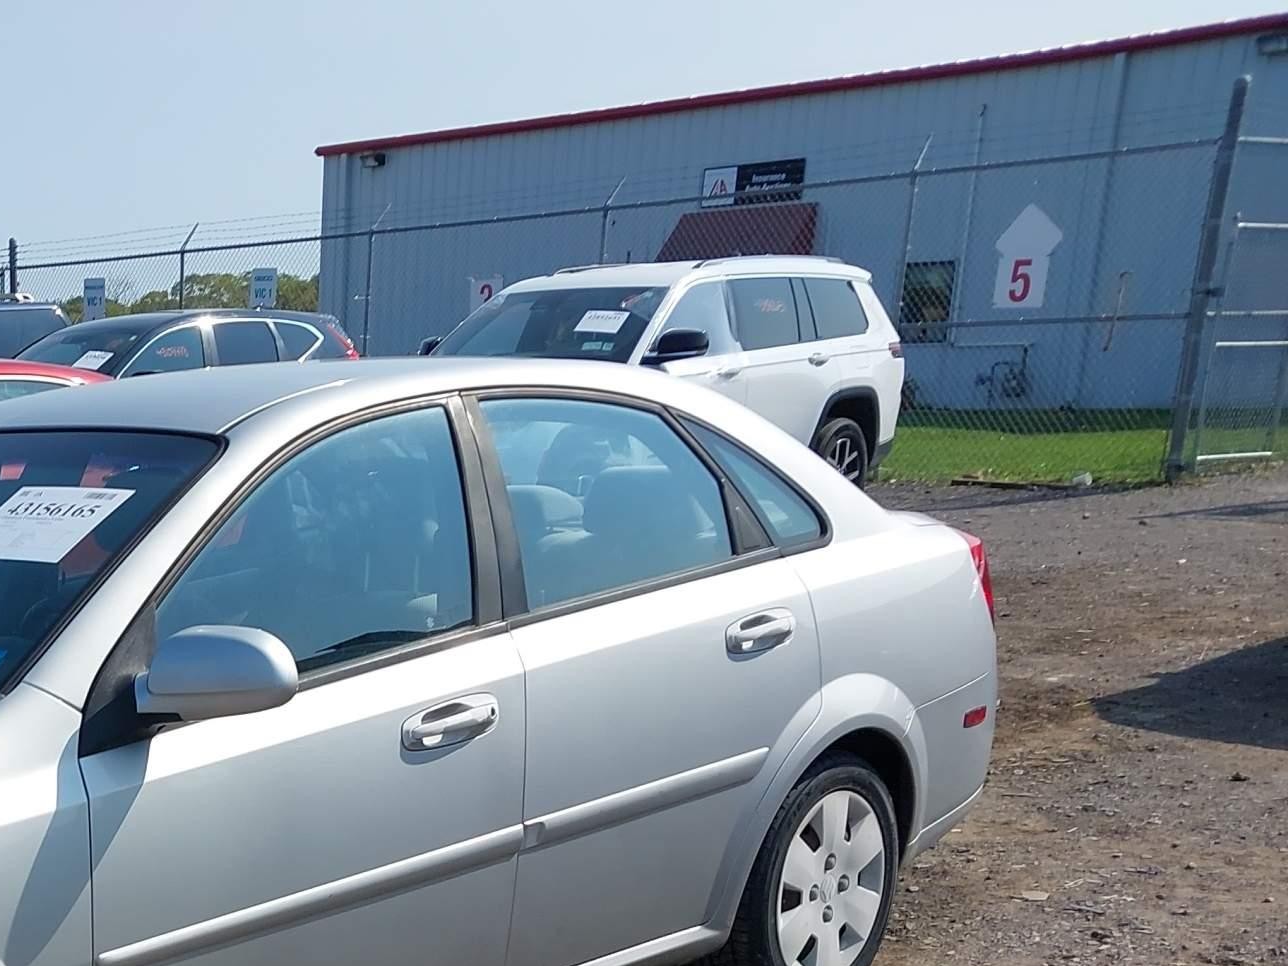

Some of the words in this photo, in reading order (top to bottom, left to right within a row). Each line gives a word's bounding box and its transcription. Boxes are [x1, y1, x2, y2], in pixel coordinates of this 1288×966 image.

[1009, 259, 1032, 302] 5
[254, 287, 267, 299] VIC
[268, 287, 273, 298] 1
[87, 296, 98, 306] VIC
[8, 502, 102, 519] 43156165
